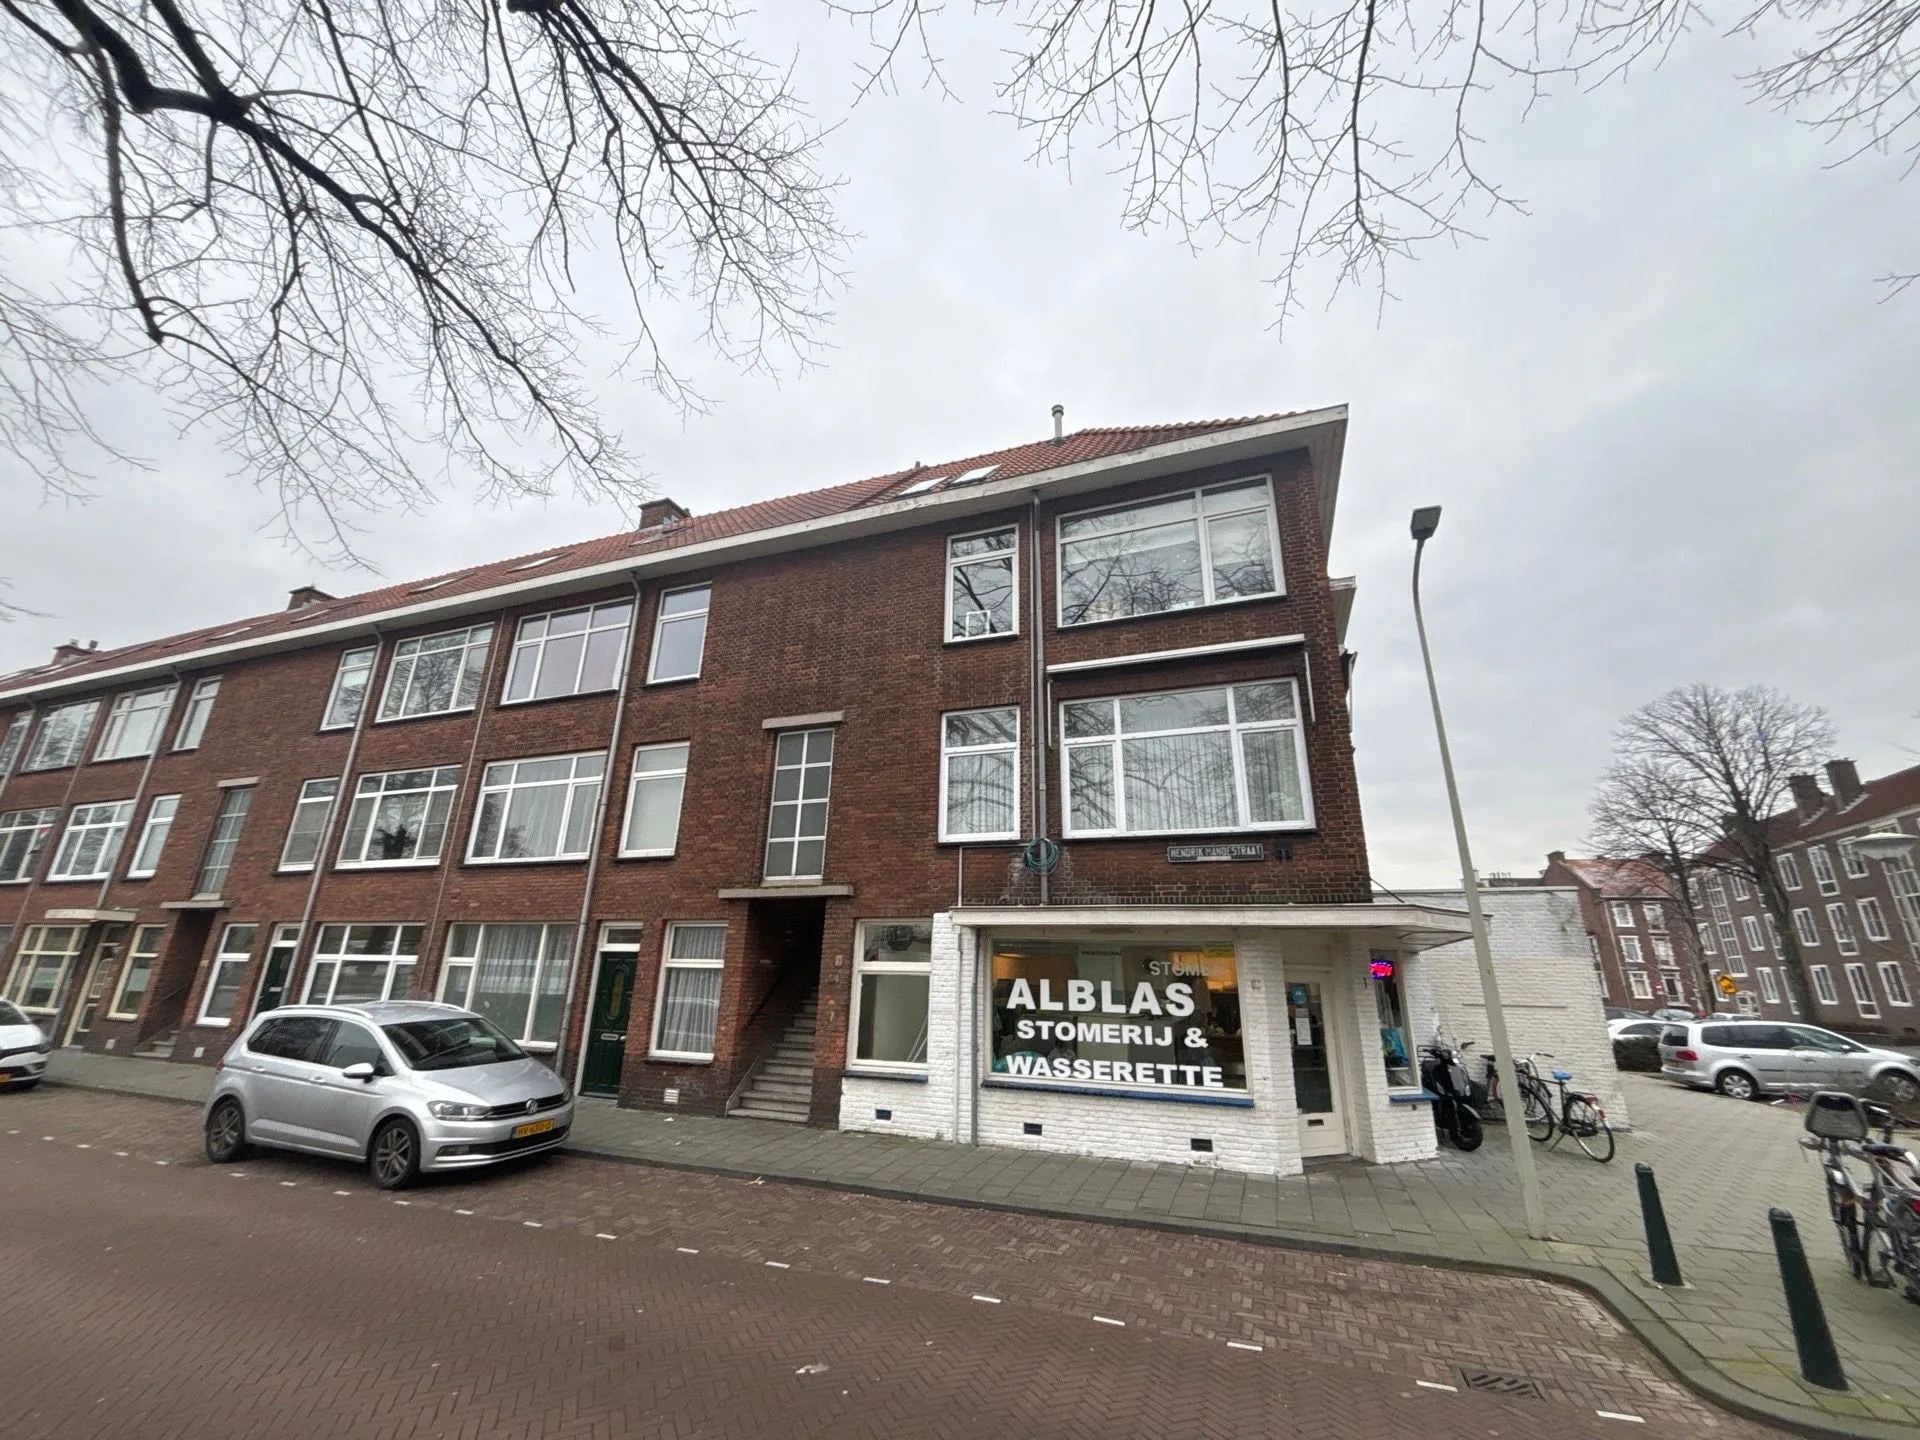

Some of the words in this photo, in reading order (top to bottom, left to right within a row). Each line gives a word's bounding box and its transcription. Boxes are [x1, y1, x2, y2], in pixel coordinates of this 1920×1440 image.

[1170, 848, 1204, 858] HENDRIK
[1006, 978, 1195, 1017] ALBLAS
[1017, 1020, 1172, 1047] STOMERIJ
[1184, 1027, 1208, 1049] &
[1006, 1055, 1224, 1087] WASSERETTE
